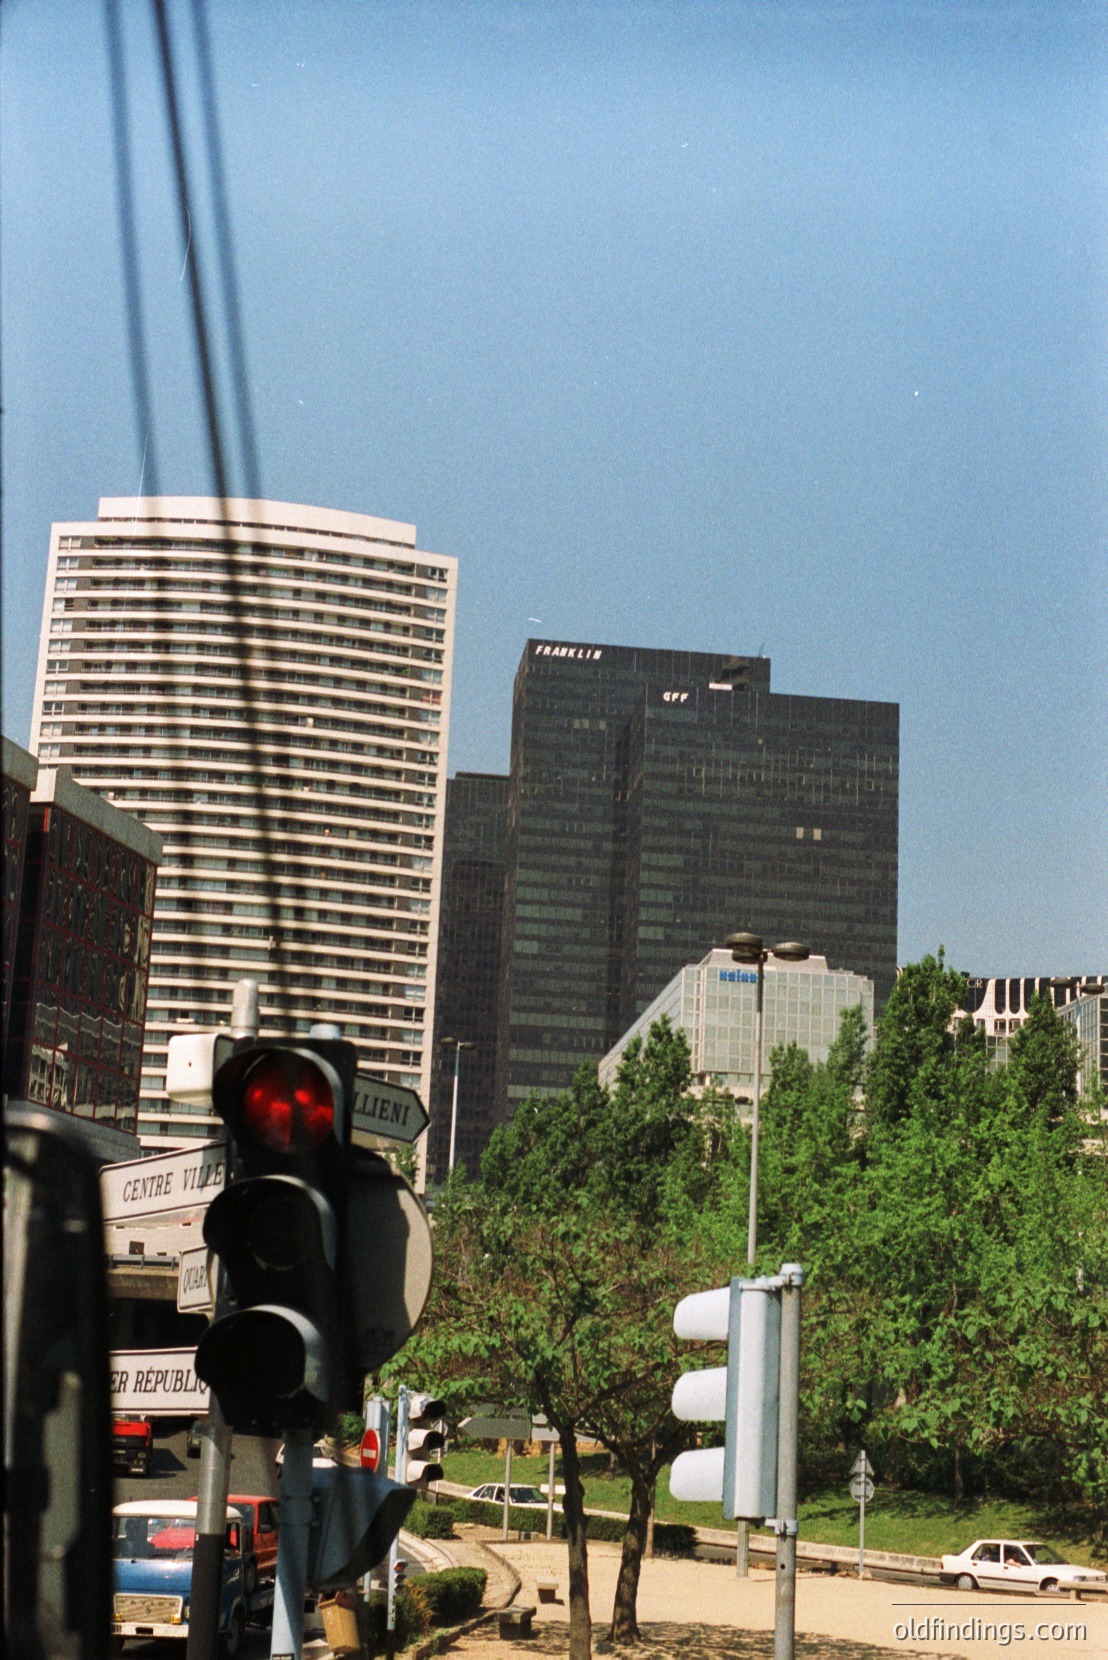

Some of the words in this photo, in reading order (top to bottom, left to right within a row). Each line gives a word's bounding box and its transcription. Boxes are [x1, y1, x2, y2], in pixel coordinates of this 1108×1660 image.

[535, 645, 602, 660] FRANKLIN
[123, 1172, 174, 1202] CENTRE
[183, 1162, 224, 1192] VILLE
